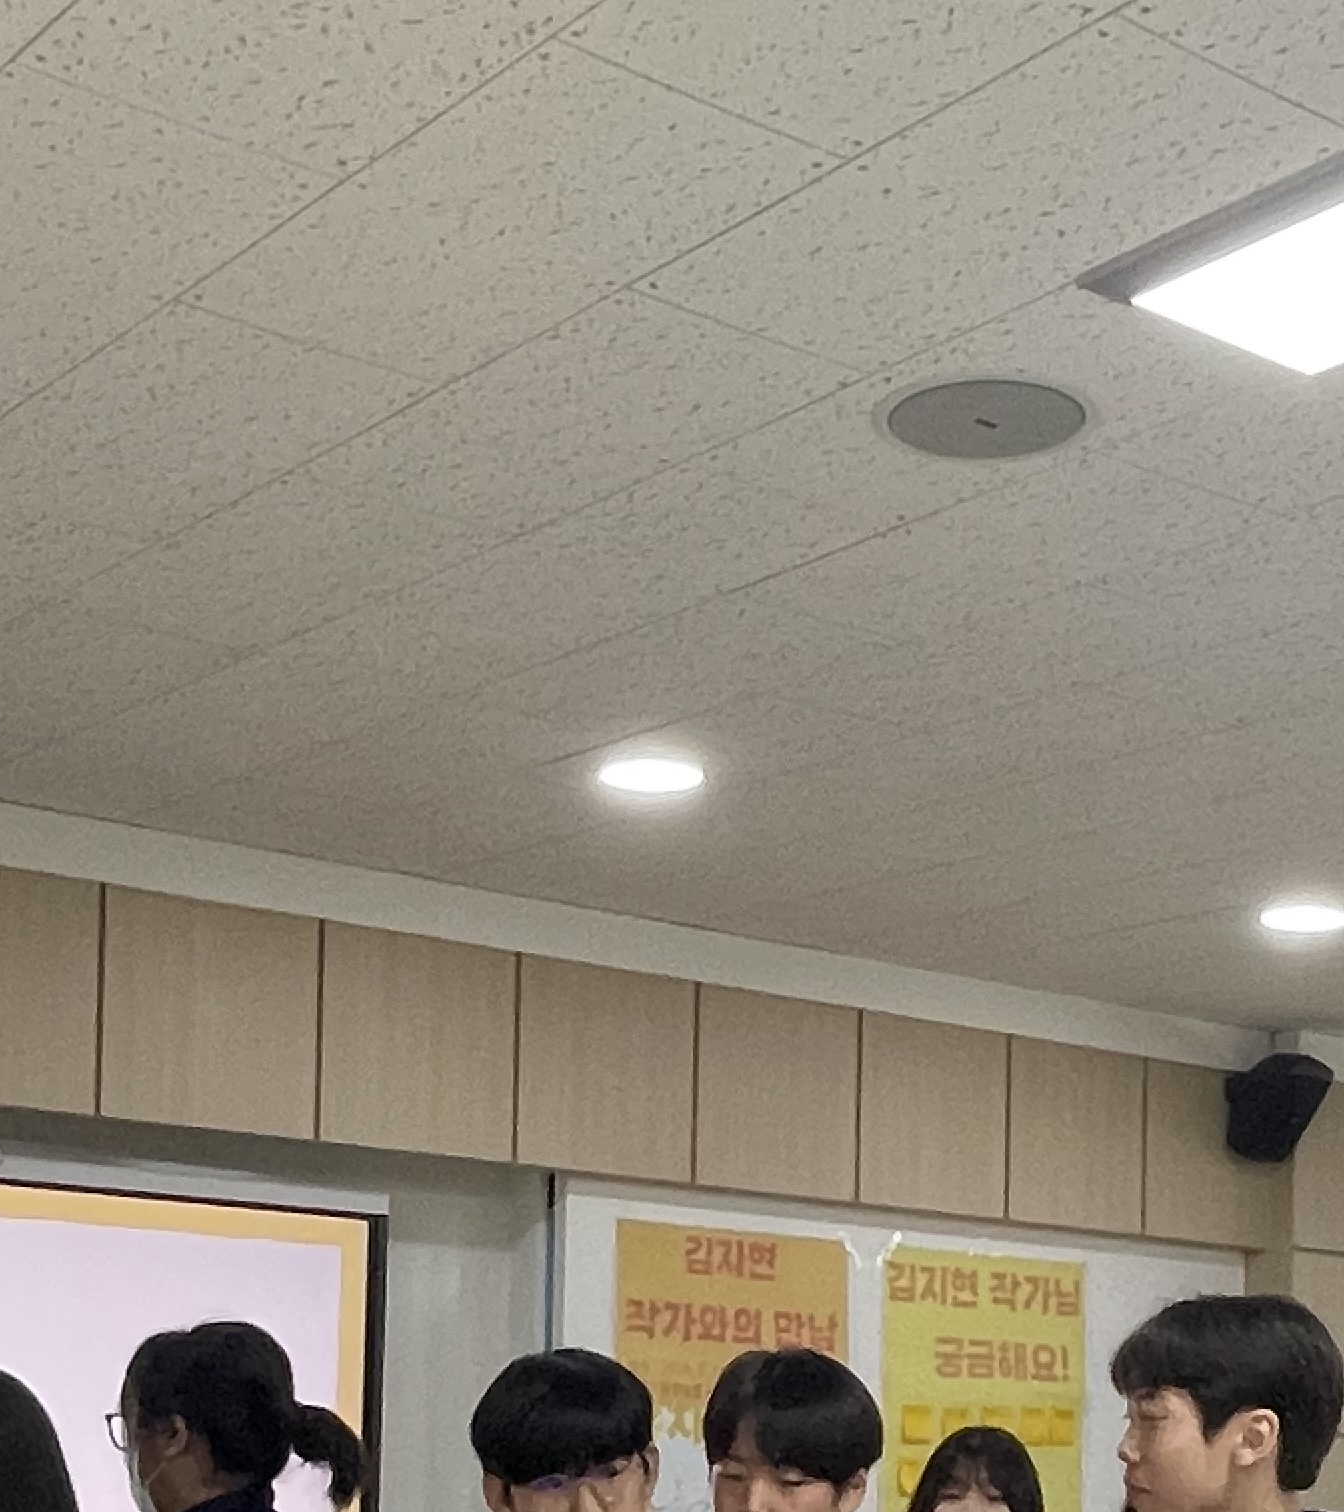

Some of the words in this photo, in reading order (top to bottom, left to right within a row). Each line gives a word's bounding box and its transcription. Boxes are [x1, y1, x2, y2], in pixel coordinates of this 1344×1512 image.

[685, 1235, 777, 1281] 김지현
[887, 1261, 980, 1308] 김지현
[989, 1271, 1081, 1317] 작가님
[624, 1299, 762, 1345] 작가와의
[935, 1336, 1070, 1382] 궁금해요!
